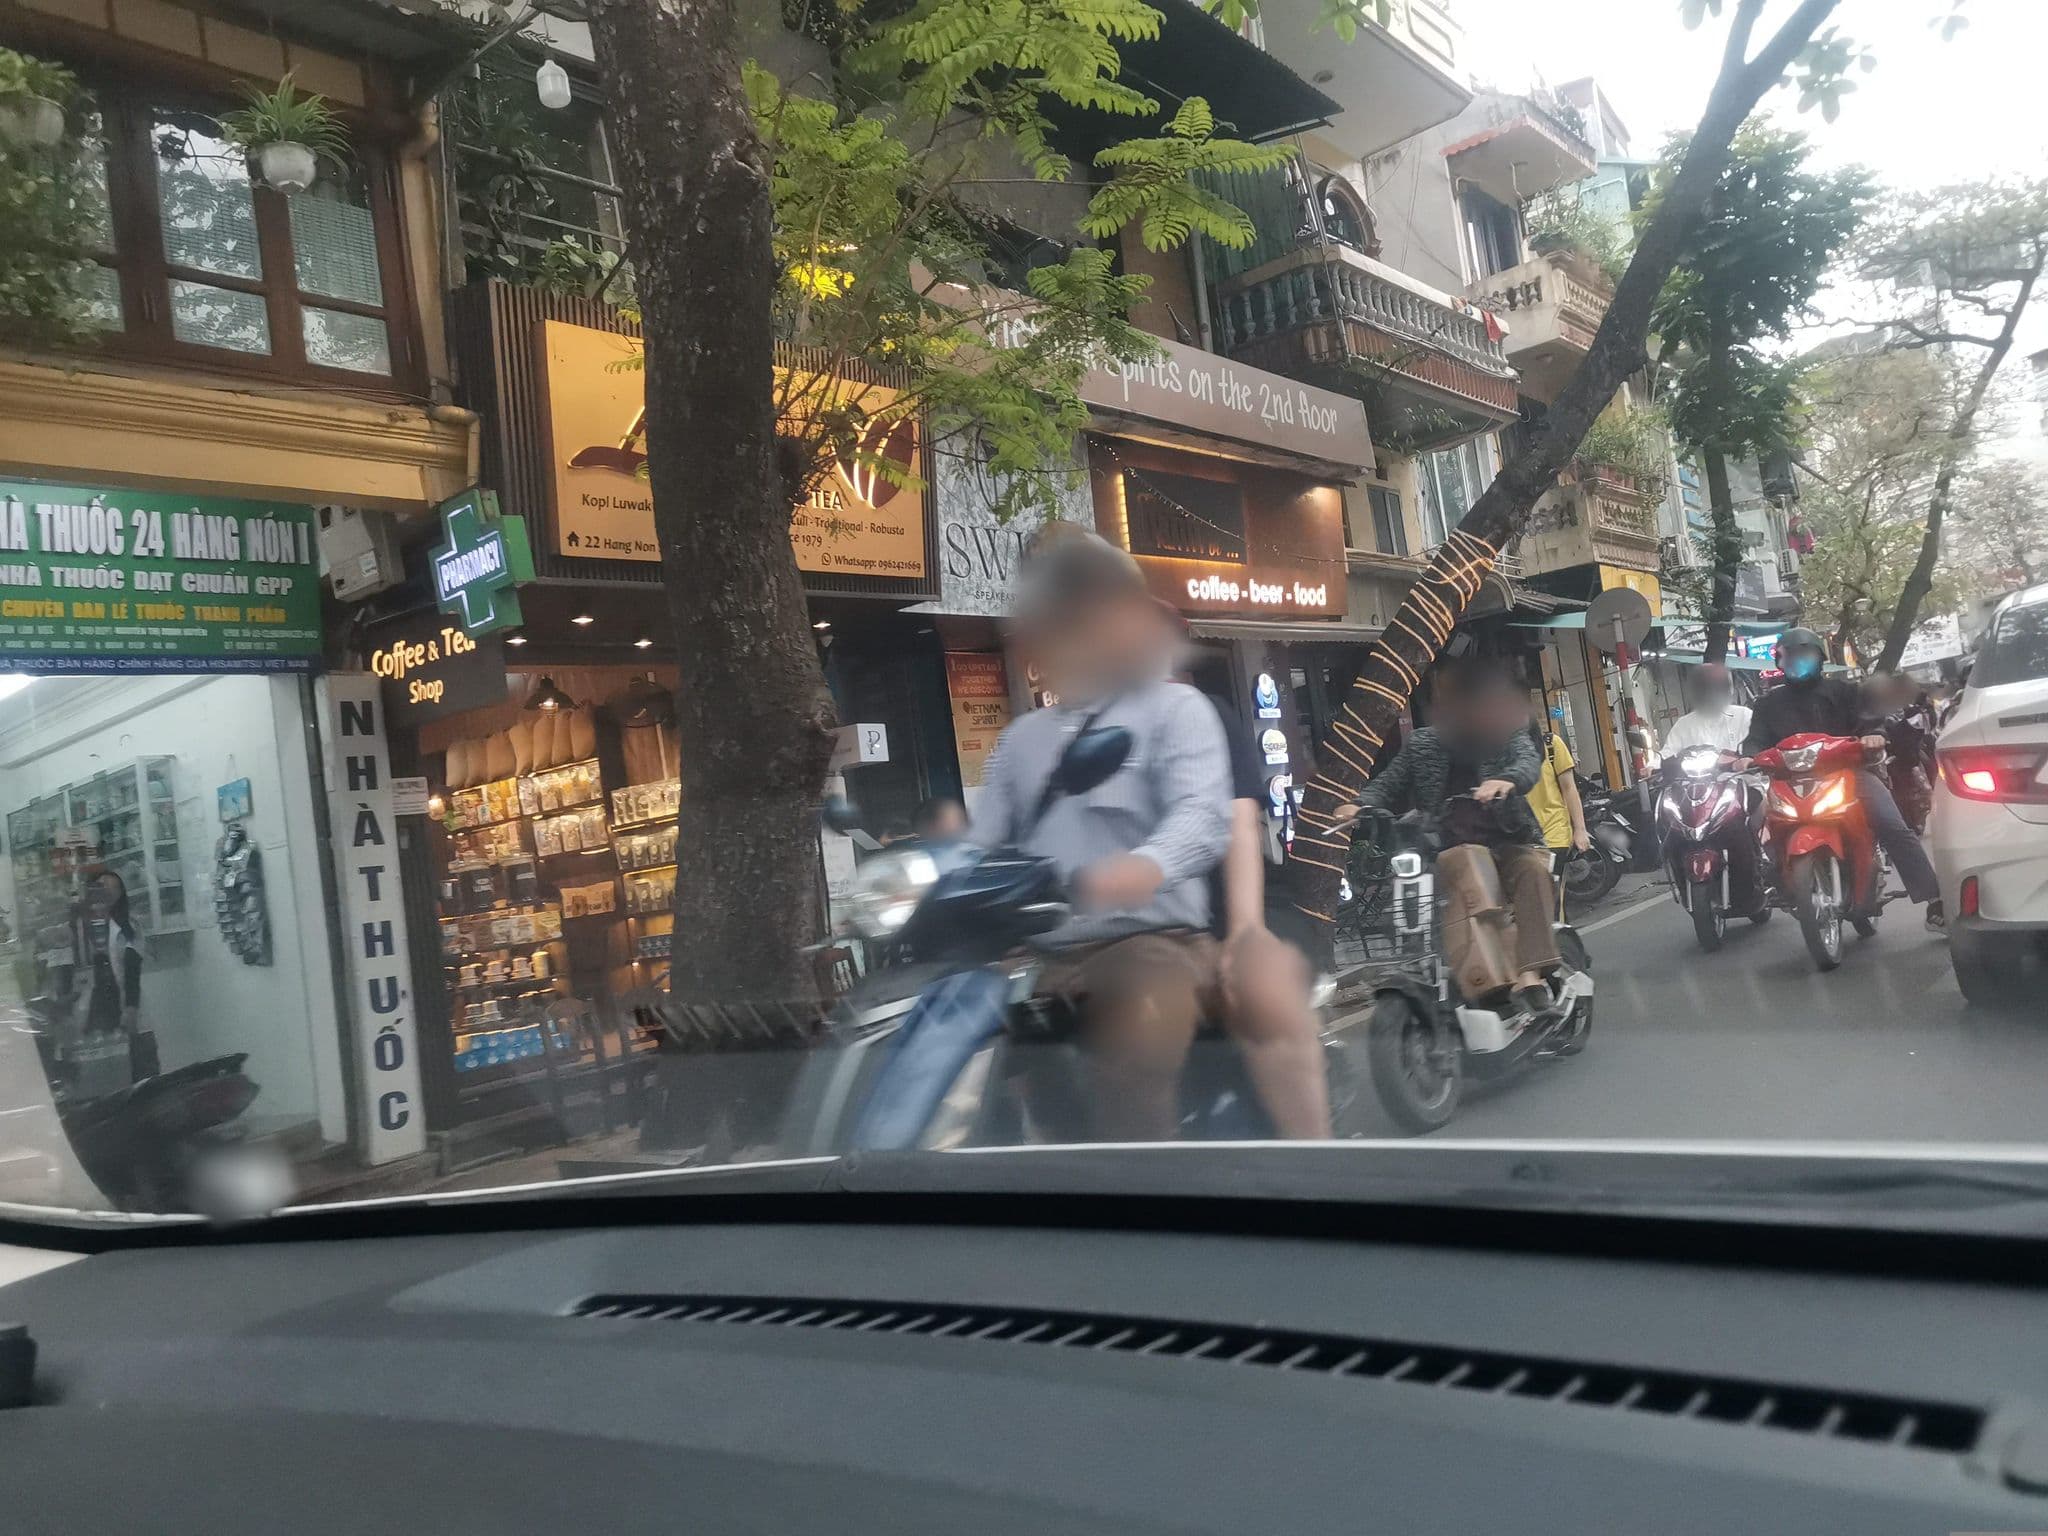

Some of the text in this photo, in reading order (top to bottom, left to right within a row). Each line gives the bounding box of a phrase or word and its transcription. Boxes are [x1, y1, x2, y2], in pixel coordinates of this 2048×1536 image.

[1189, 368, 1213, 404] on
[1218, 367, 1254, 413] the
[1259, 383, 1294, 425] 2nd
[1298, 390, 1338, 435] floor
[613, 496, 652, 512] Luwak
[811, 489, 844, 512] TEA
[34, 494, 124, 556] THUỐC
[131, 508, 165, 557] 24
[171, 506, 241, 561] HÀNG
[245, 511, 296, 564] NÓN
[802, 534, 823, 548] 1979
[870, 522, 905, 536] Robusta
[584, 535, 656, 555] 22 Hang Non
[440, 539, 501, 592] PHARMACY
[834, 555, 877, 570] Whatsapp:
[49, 562, 125, 590] THUỐC
[181, 567, 249, 594] CHUẨN
[255, 576, 293, 596] GPP
[1187, 575, 1240, 602] coffee
[1249, 578, 1284, 604] beer
[1294, 581, 1327, 607] food
[371, 640, 425, 680] Coffee
[428, 640, 440, 661] &
[408, 678, 444, 703] Shop
